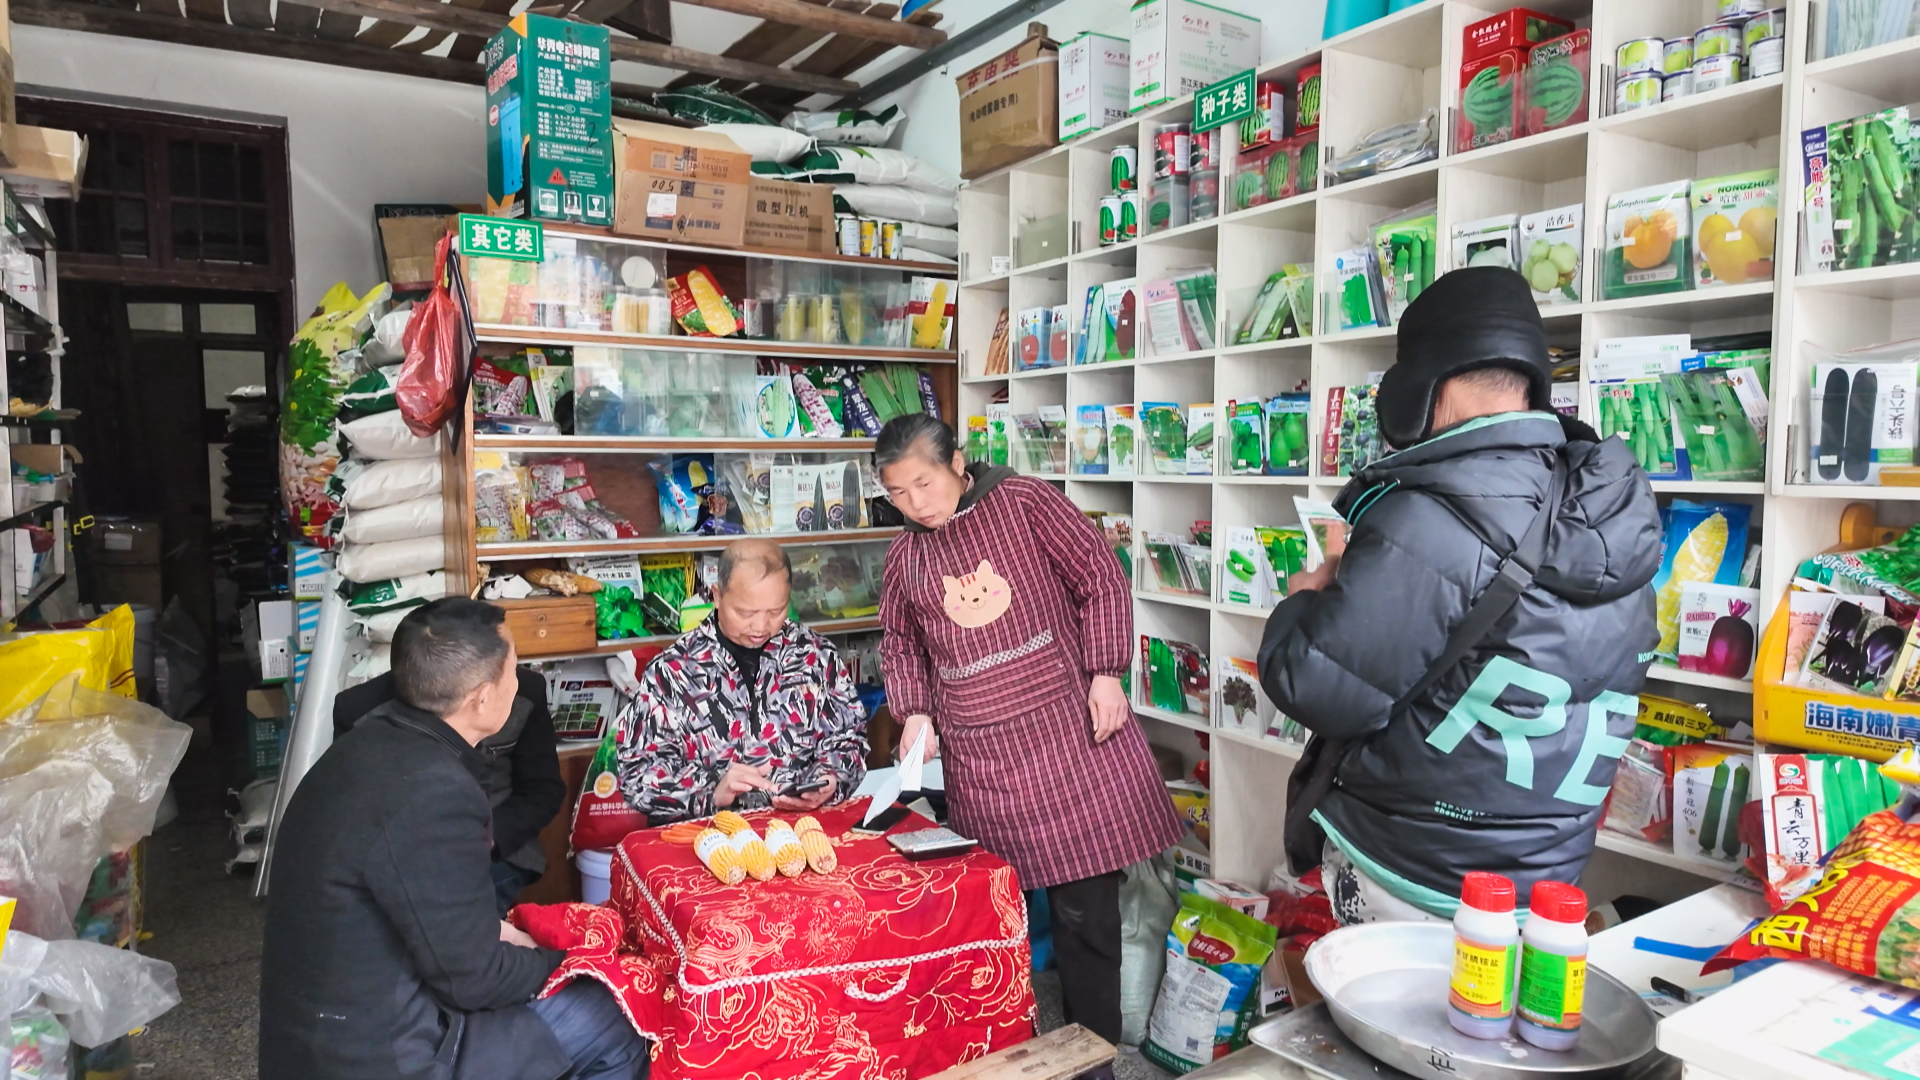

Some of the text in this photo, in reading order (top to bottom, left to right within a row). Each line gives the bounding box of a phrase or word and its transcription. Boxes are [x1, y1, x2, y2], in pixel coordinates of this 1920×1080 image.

[1201, 82, 1247, 122] 种子类
[756, 199, 810, 219] 微型电机
[471, 223, 534, 253] 其它类
[1434, 806, 1472, 822] cheerful
[1782, 797, 1812, 865] 青云万里
